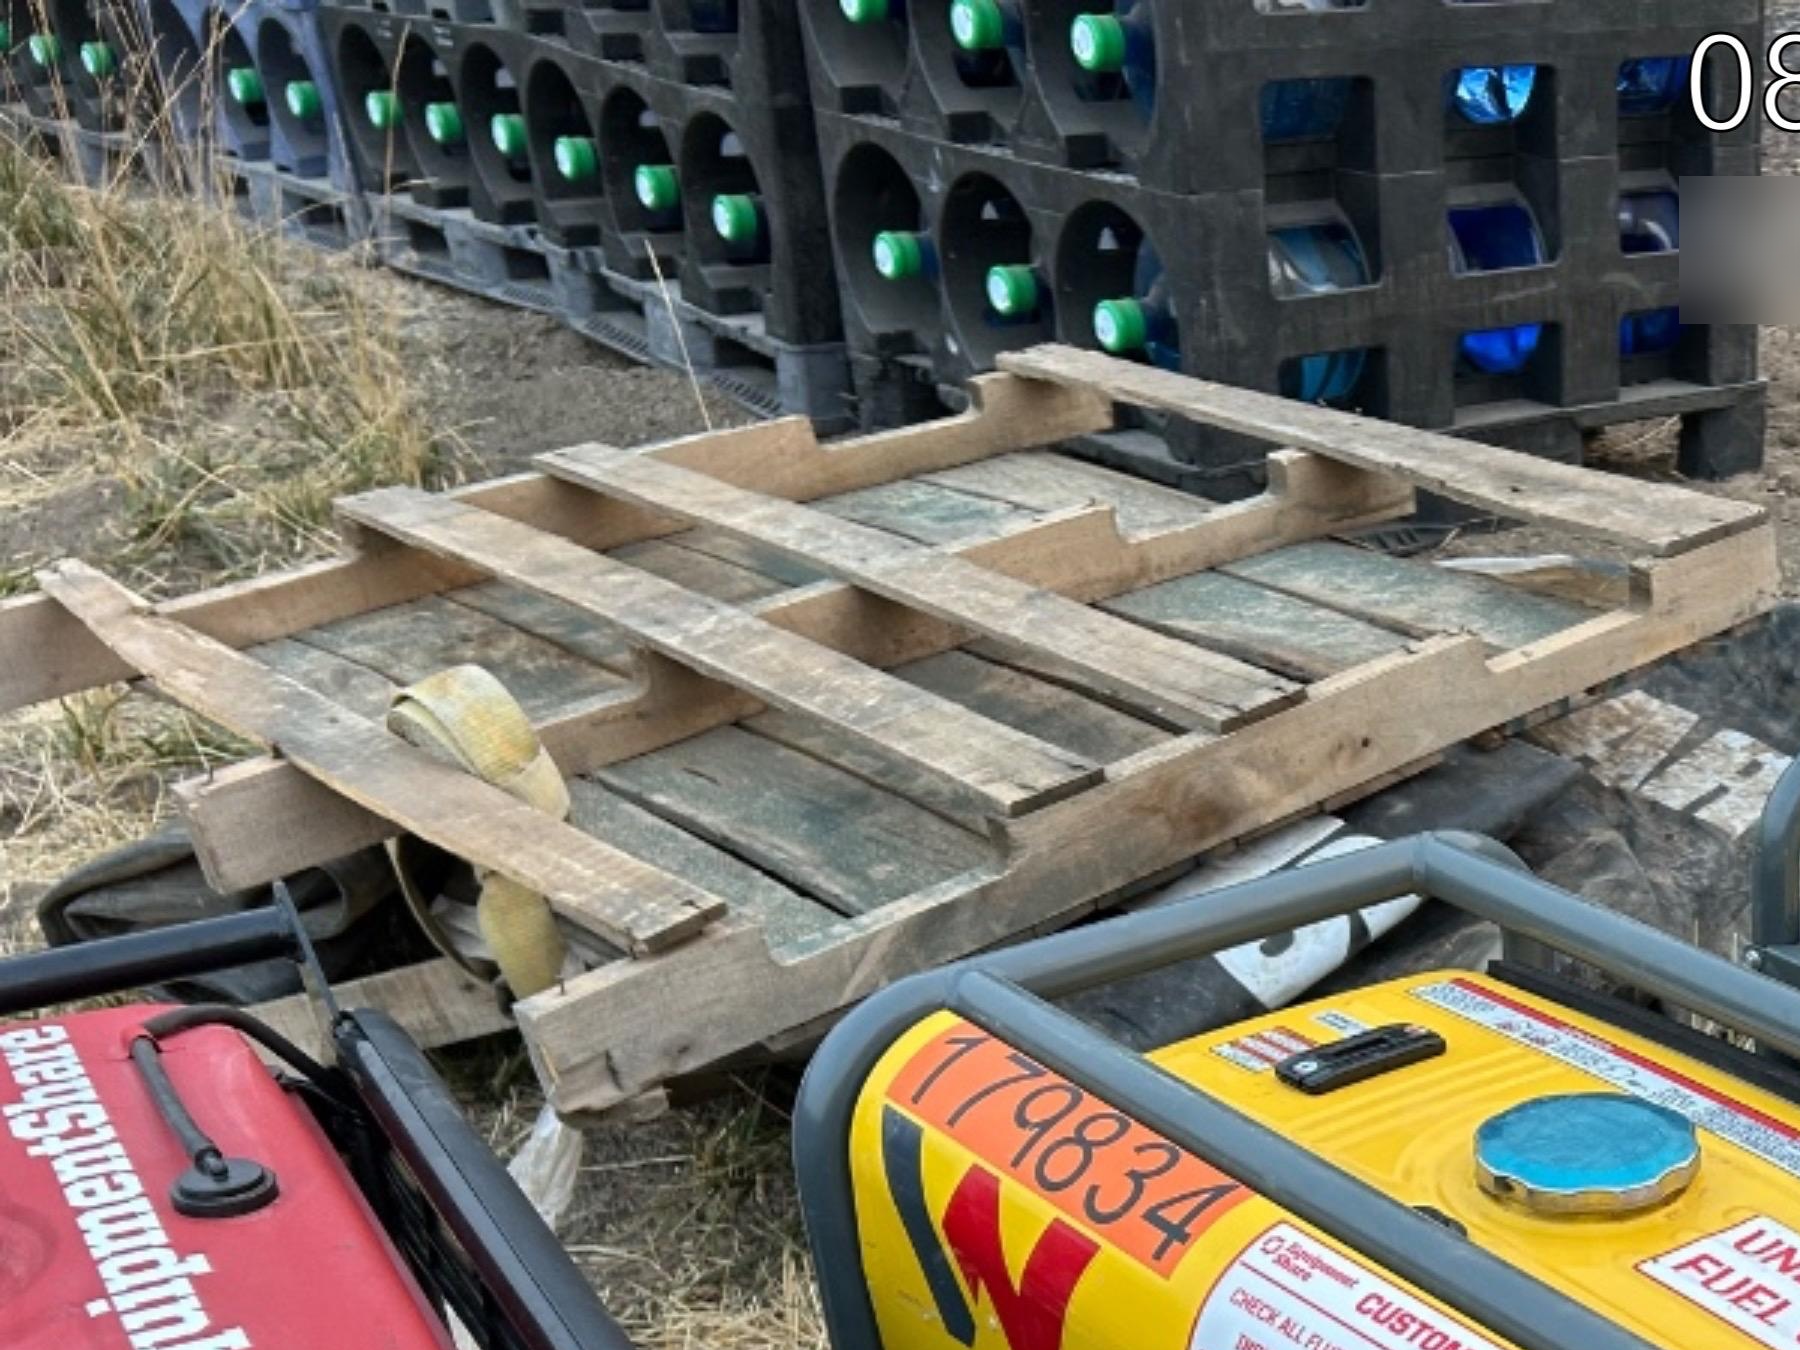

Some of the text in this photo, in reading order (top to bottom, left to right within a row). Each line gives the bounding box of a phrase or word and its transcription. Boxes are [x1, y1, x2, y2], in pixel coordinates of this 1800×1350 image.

[910, 1036, 1242, 1261] 179834
[1272, 1253, 1312, 1282] Share
[1286, 1241, 1360, 1289] Equipment
[1669, 1252, 1792, 1327] FUEL
[1230, 1287, 1281, 1326] CHECK
[1278, 1317, 1306, 1345] ALL
